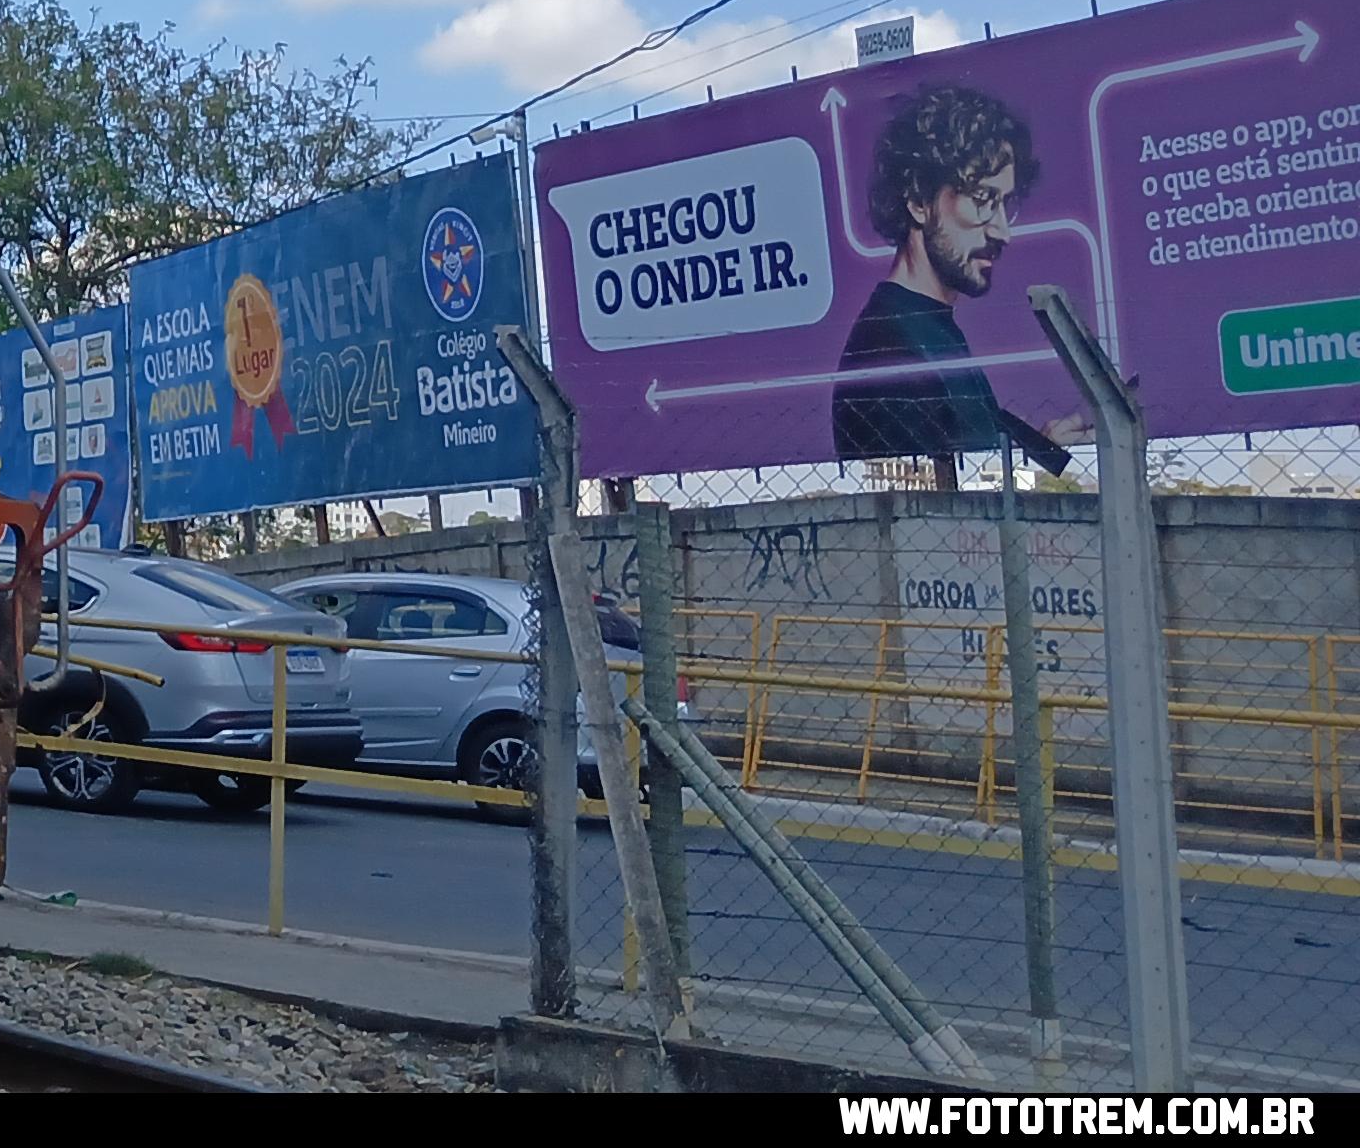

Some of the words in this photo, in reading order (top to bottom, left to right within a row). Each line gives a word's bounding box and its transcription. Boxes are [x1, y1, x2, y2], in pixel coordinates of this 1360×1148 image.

[1139, 128, 1228, 163] Acesse
[1232, 125, 1250, 146] o
[1254, 114, 1314, 149] app,
[1142, 175, 1158, 197] o
[1163, 166, 1211, 201] que
[1216, 147, 1272, 185] está
[589, 184, 756, 259] CHEGOU
[1145, 210, 1161, 231] e
[1164, 192, 1251, 229] receba
[1149, 236, 1181, 266] de
[595, 268, 623, 315] O
[630, 248, 744, 309] ONDE
[749, 241, 809, 293] IR.
[141, 317, 154, 348] A
[156, 302, 211, 344] ESCOLA
[272, 255, 393, 349] ENEM
[144, 348, 175, 387] QUE
[176, 339, 214, 376] MAIS
[234, 348, 275, 378] Lugar
[437, 328, 487, 360] Colégio
[148, 379, 218, 426] APROVA
[290, 339, 400, 435] 2024
[416, 359, 518, 416] Batista
[150, 429, 172, 465] EM
[174, 423, 221, 462] BETIM
[443, 418, 498, 448] Mineiro
[905, 578, 978, 610] COROA
[1032, 585, 1097, 621] ORES
